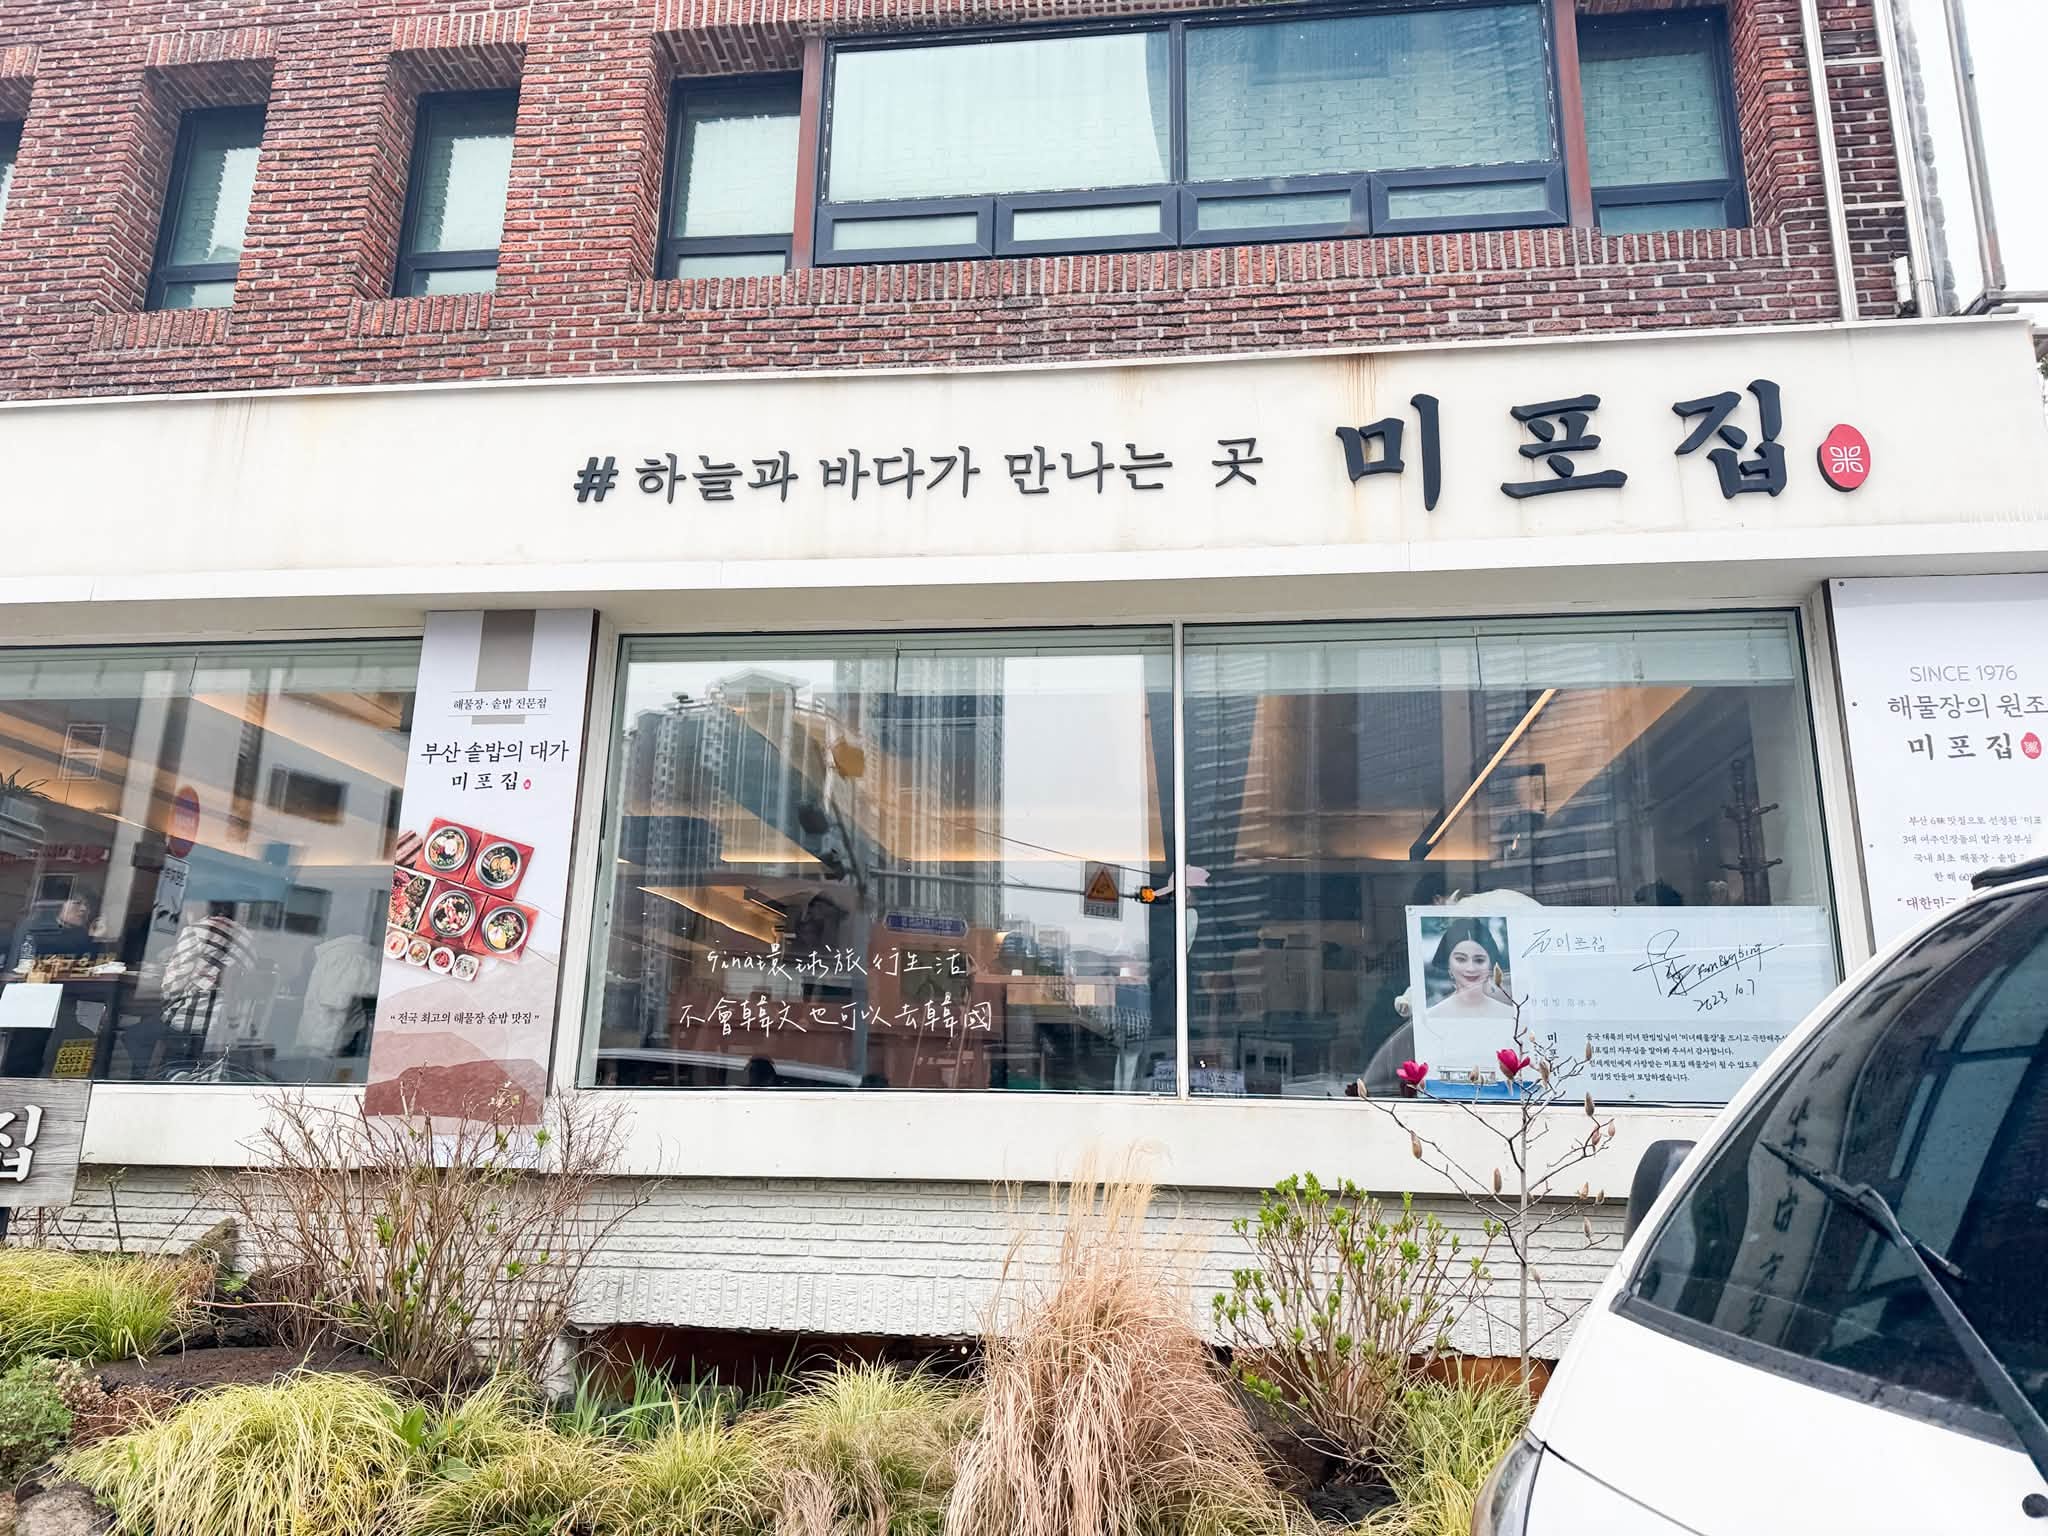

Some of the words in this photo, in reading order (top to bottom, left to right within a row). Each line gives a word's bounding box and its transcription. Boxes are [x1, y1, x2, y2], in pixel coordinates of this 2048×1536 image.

[634, 450, 799, 503] 하늘과
[818, 445, 980, 500] 바다가
[1004, 441, 1173, 495] 만나는
[1210, 437, 1264, 489] 곳
[1909, 666, 1971, 683] SINCE
[1976, 665, 2018, 681] 1976
[516, 697, 547, 709] 전문점
[1887, 693, 1990, 720] 해물장의
[1996, 692, 2048, 718] 원조
[421, 741, 461, 764] 부산
[464, 740, 523, 764] 솥밥의
[530, 740, 570, 763] 대가
[1907, 731, 2013, 761] 미포집
[451, 771, 519, 791] 미포집
[420, 1012, 451, 1025] 최고의
[454, 1012, 486, 1025] 해물장
